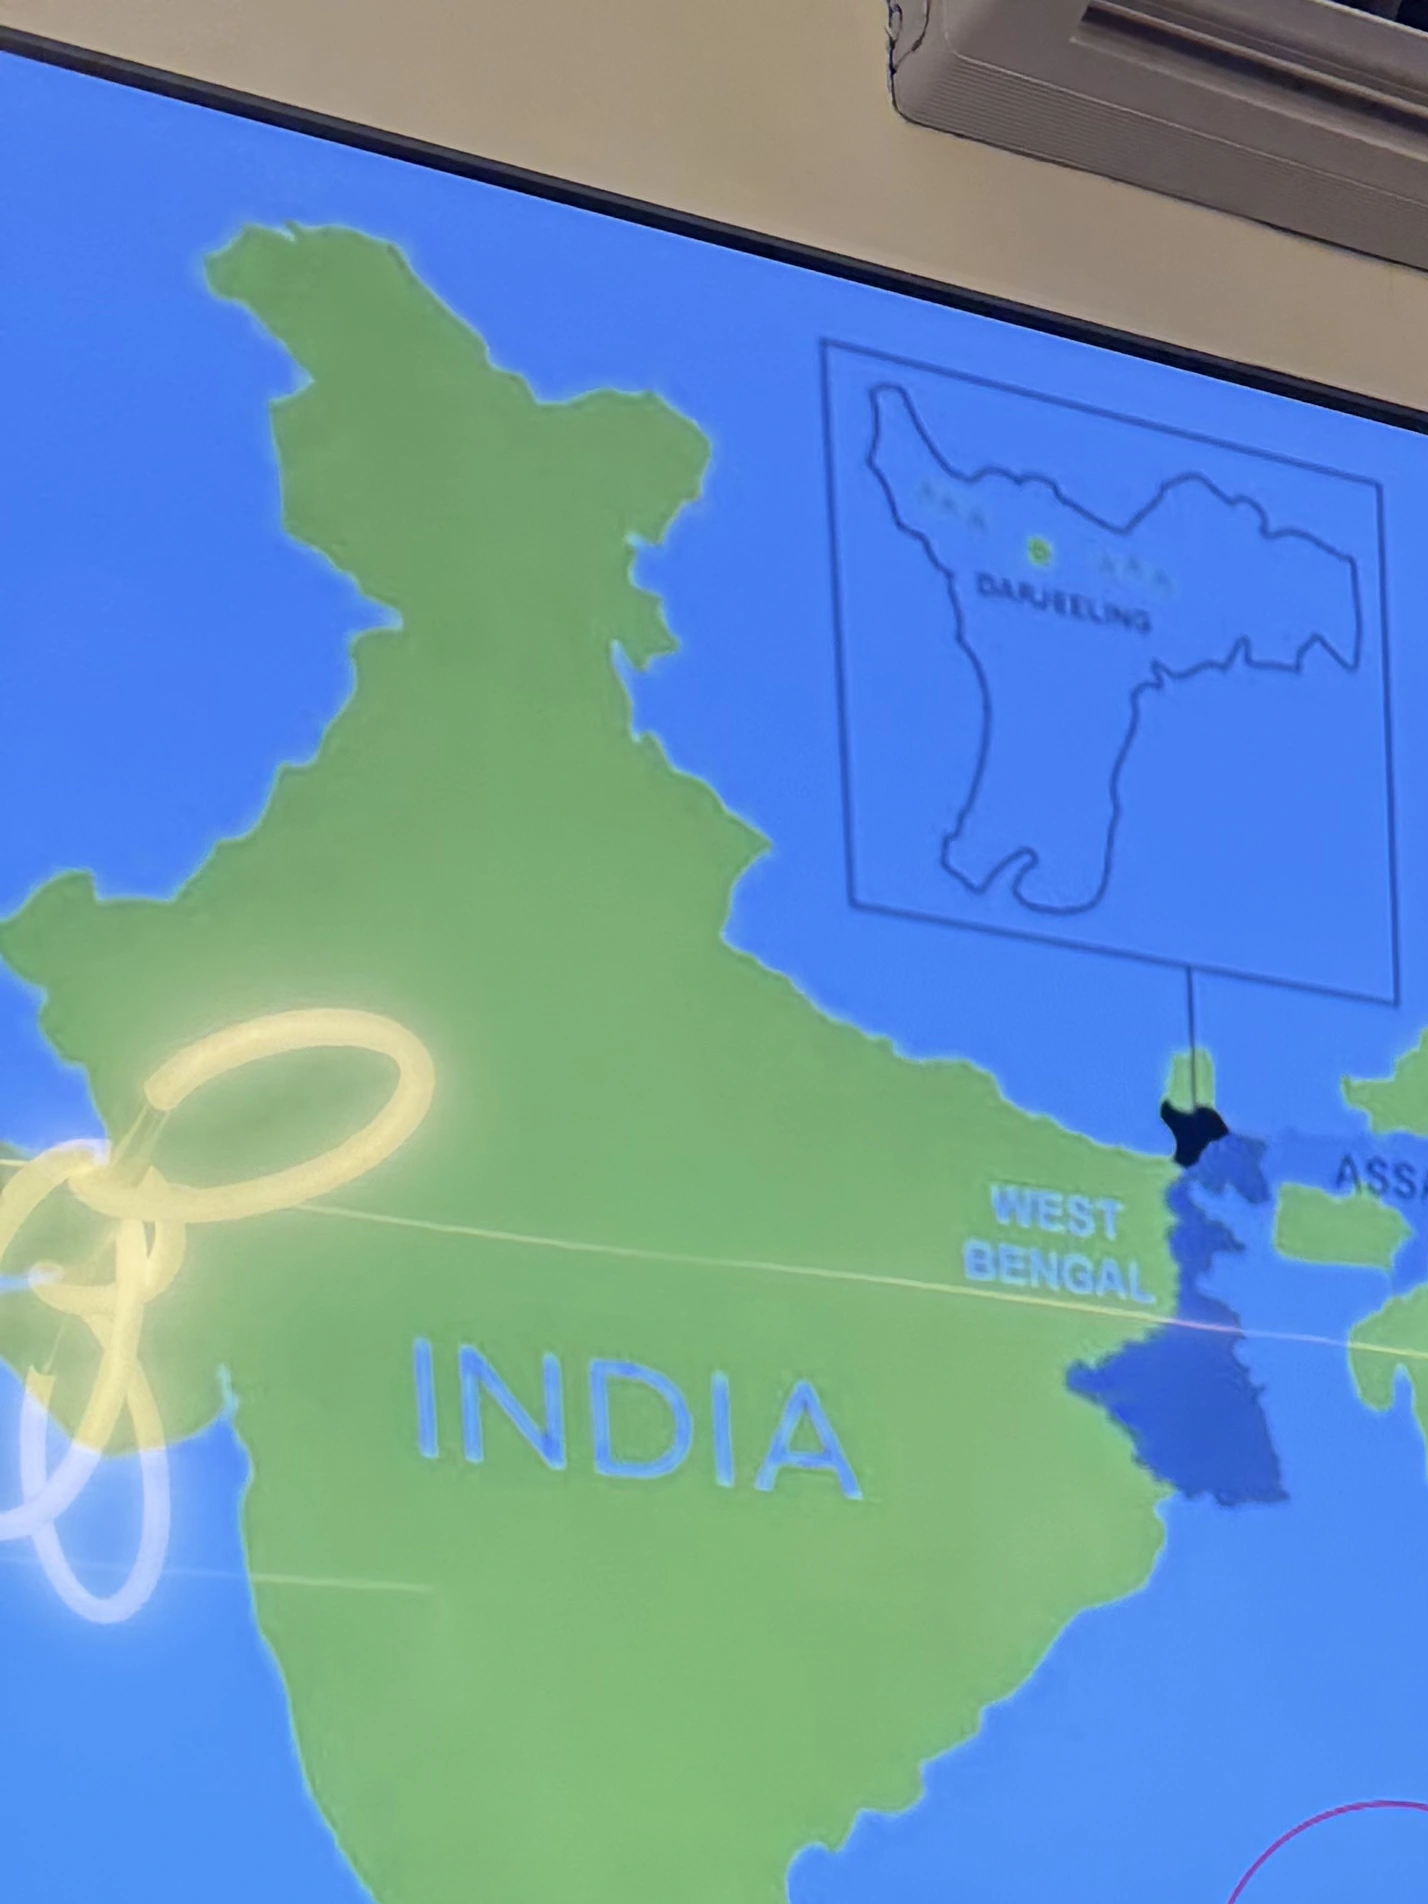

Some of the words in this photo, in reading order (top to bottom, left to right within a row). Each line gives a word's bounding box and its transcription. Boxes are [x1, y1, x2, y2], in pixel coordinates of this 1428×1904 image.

[976, 571, 1152, 635] DARJEELING
[990, 1182, 1125, 1241] WEST
[963, 1238, 1157, 1305] BENGAL
[413, 1335, 863, 1500] INDIA
